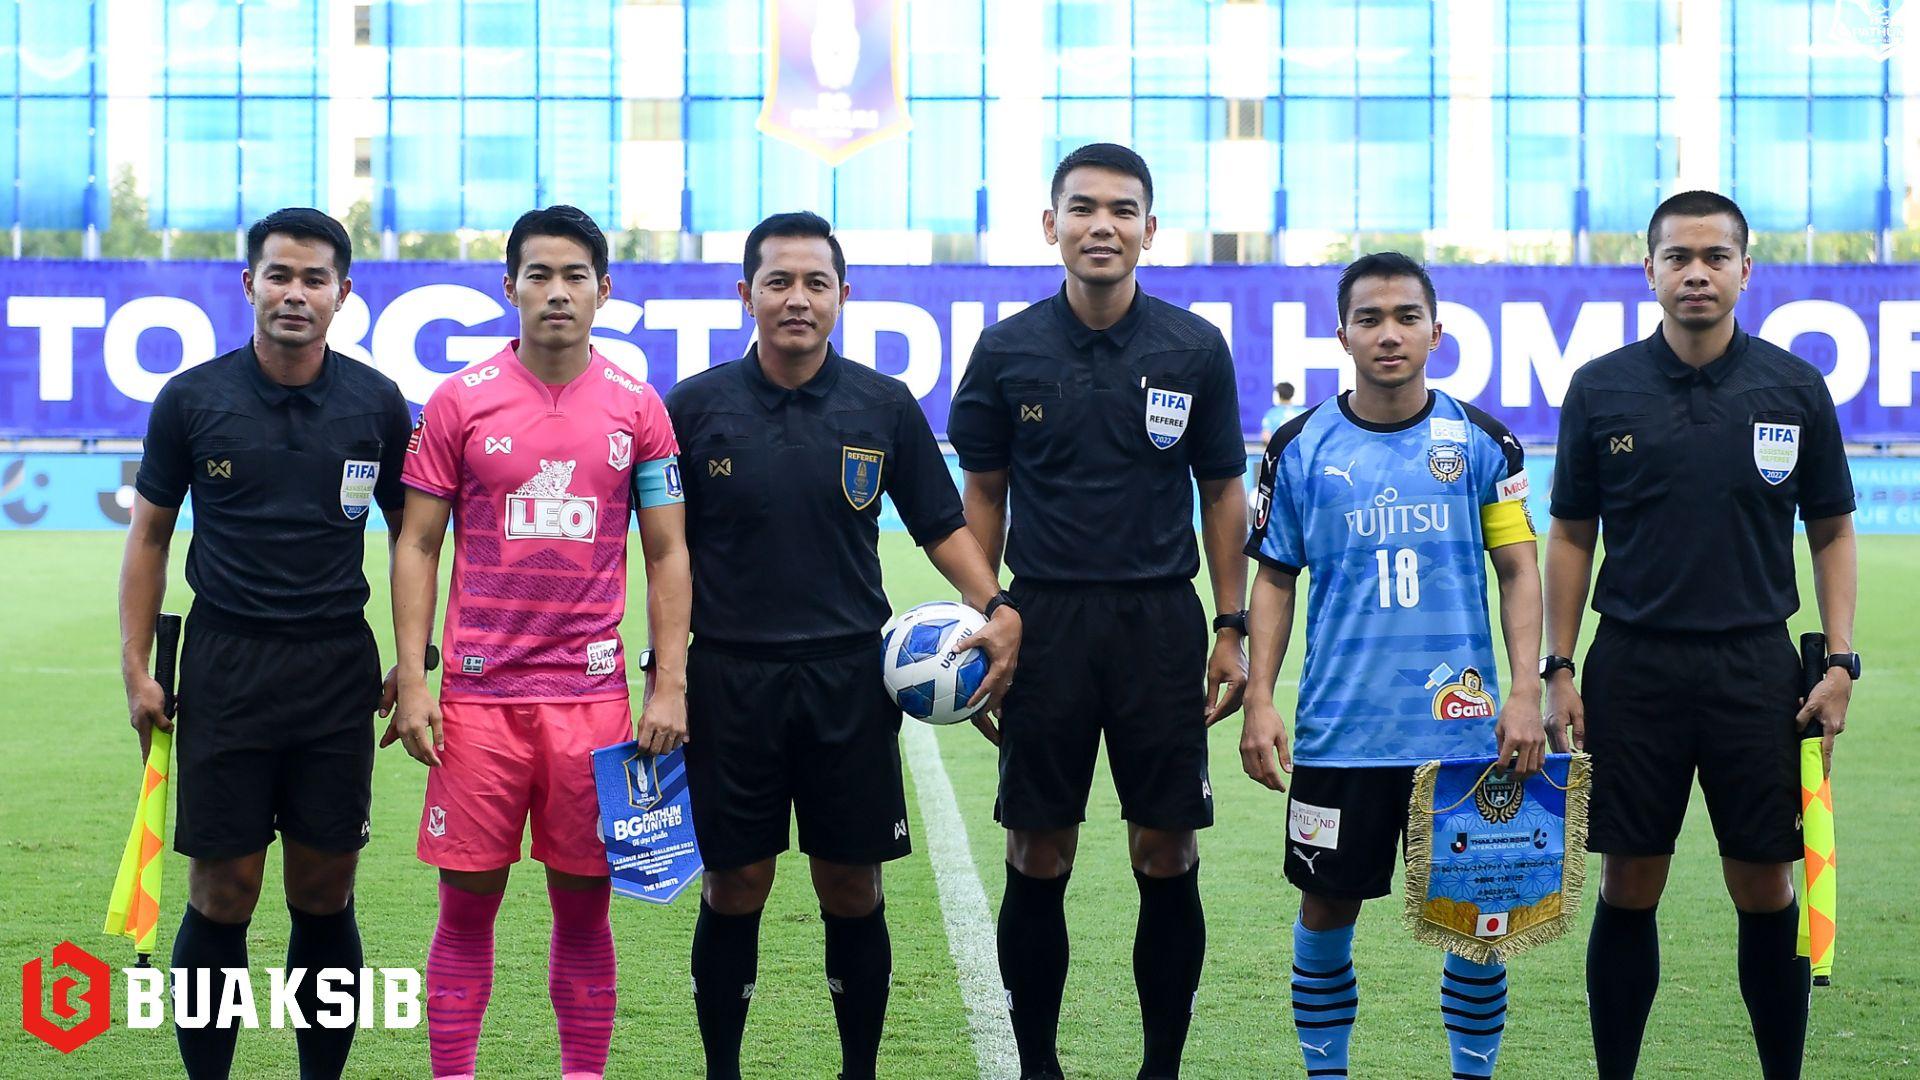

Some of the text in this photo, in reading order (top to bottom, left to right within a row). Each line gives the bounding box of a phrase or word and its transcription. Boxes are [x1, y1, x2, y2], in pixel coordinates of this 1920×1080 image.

[6, 295, 217, 404] TO
[1272, 301, 1664, 408] HOM
[462, 366, 500, 387] BG
[1151, 392, 1187, 411] FIFA
[1149, 414, 1184, 428] REFEREE
[1155, 436, 1171, 444] 2022
[1758, 426, 1794, 443] FIFA
[847, 451, 879, 463] REFEREE
[346, 464, 375, 479] FIFA
[1767, 470, 1783, 479] 2022
[510, 499, 594, 538] LEO
[1344, 503, 1449, 544] FUJITSU
[1375, 548, 1419, 608] 18
[590, 647, 615, 662] EURO
[589, 659, 614, 672] CAKE
[642, 804, 682, 822] PATHUM
[613, 816, 643, 841] BG
[643, 815, 682, 834] UNITED
